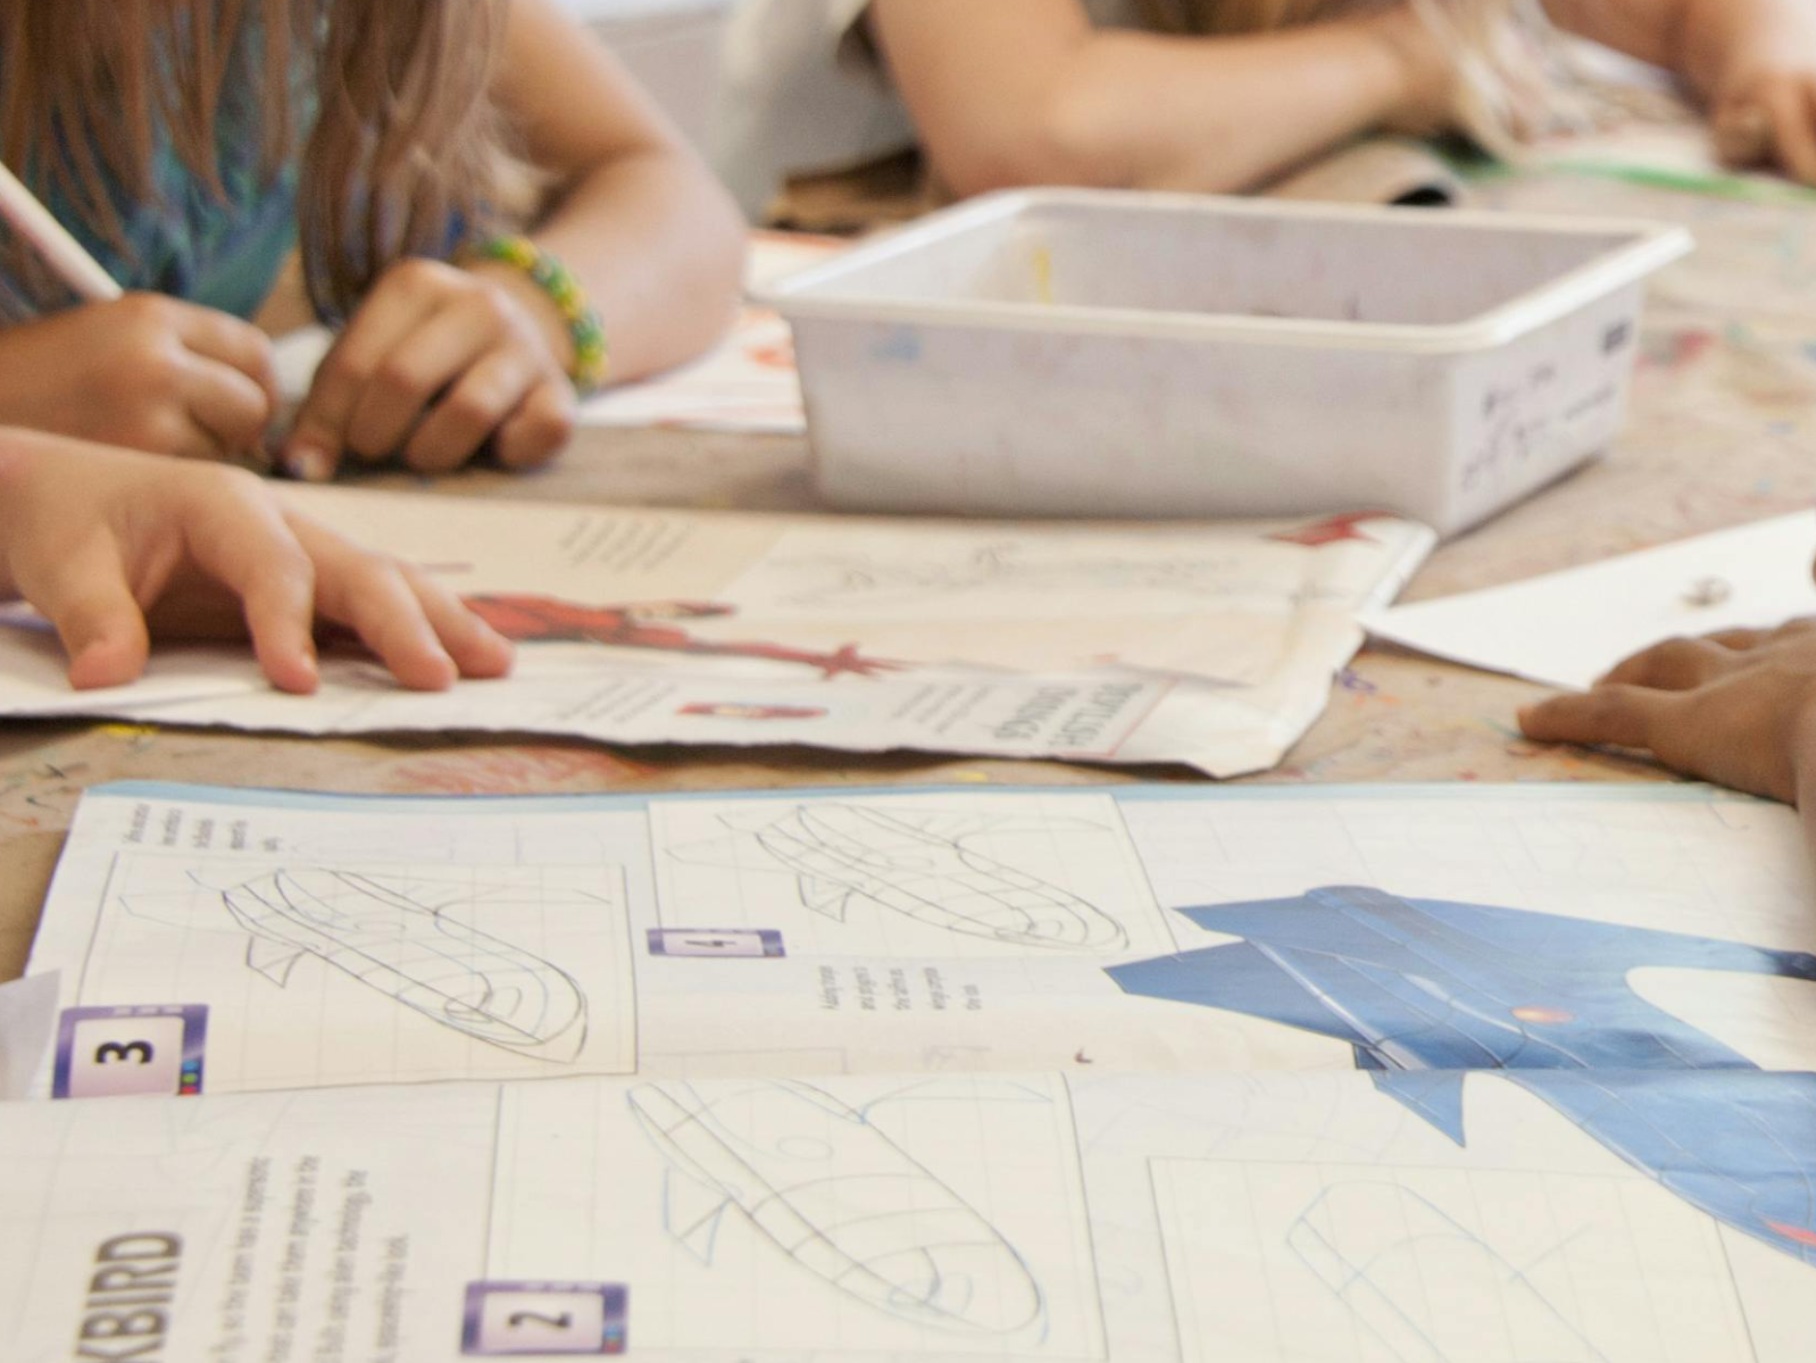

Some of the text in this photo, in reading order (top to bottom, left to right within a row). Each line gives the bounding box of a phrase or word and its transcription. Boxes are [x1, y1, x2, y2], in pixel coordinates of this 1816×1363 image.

[95, 1040, 154, 1064] 3
[75, 1230, 184, 1363] KBIRD
[507, 1309, 576, 1328] 2
